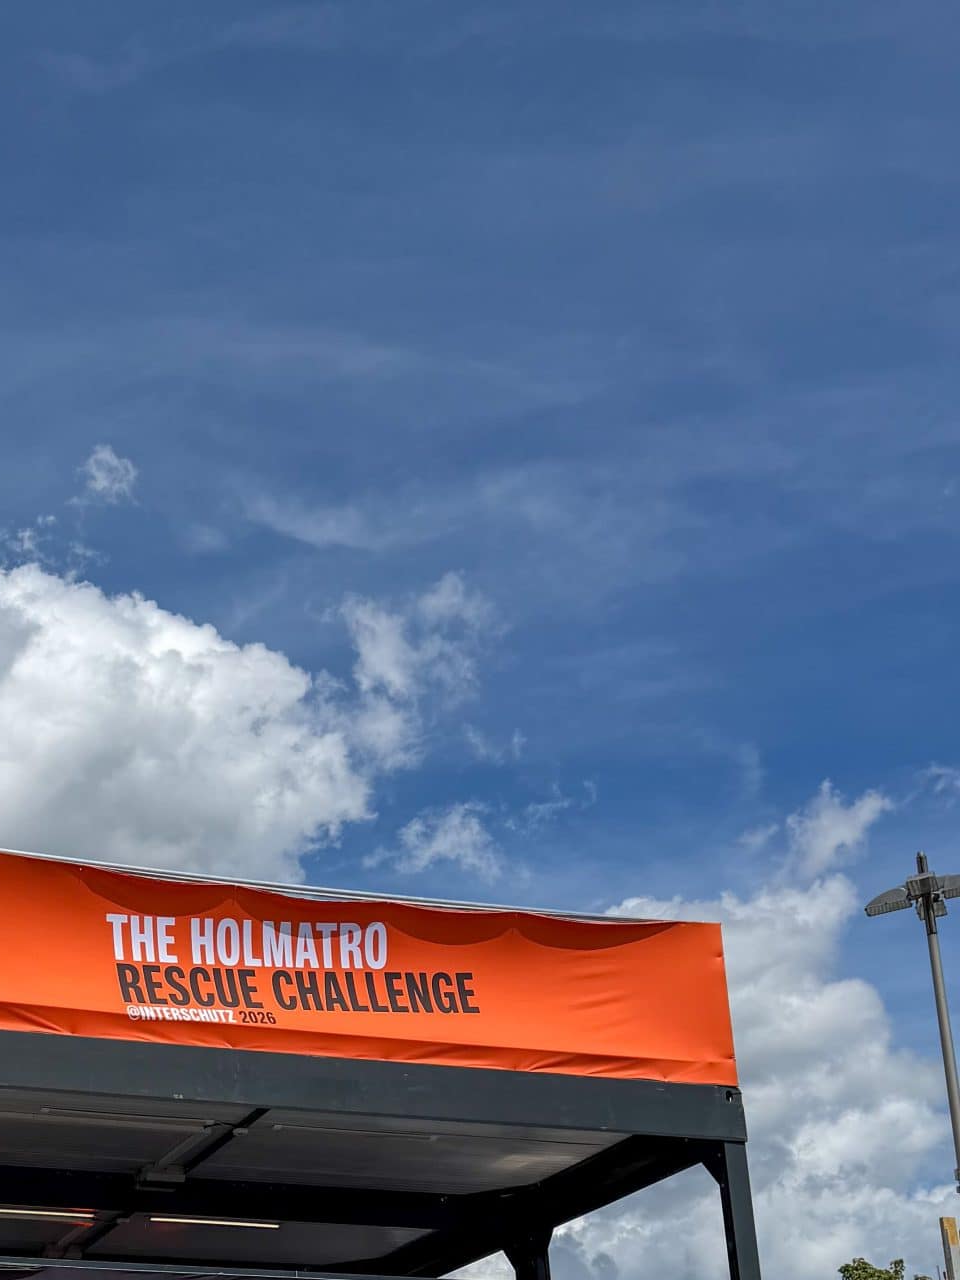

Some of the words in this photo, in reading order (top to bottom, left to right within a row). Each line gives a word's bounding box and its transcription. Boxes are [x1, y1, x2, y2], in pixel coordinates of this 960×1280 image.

[106, 913, 178, 963] THE
[191, 917, 388, 970] HOLMATRO
[116, 963, 265, 1009] RESCUE
[272, 970, 481, 1014] CHALLENGE
[127, 1005, 237, 1024] @INTERSCHUTZ
[239, 1011, 277, 1025] 2026
